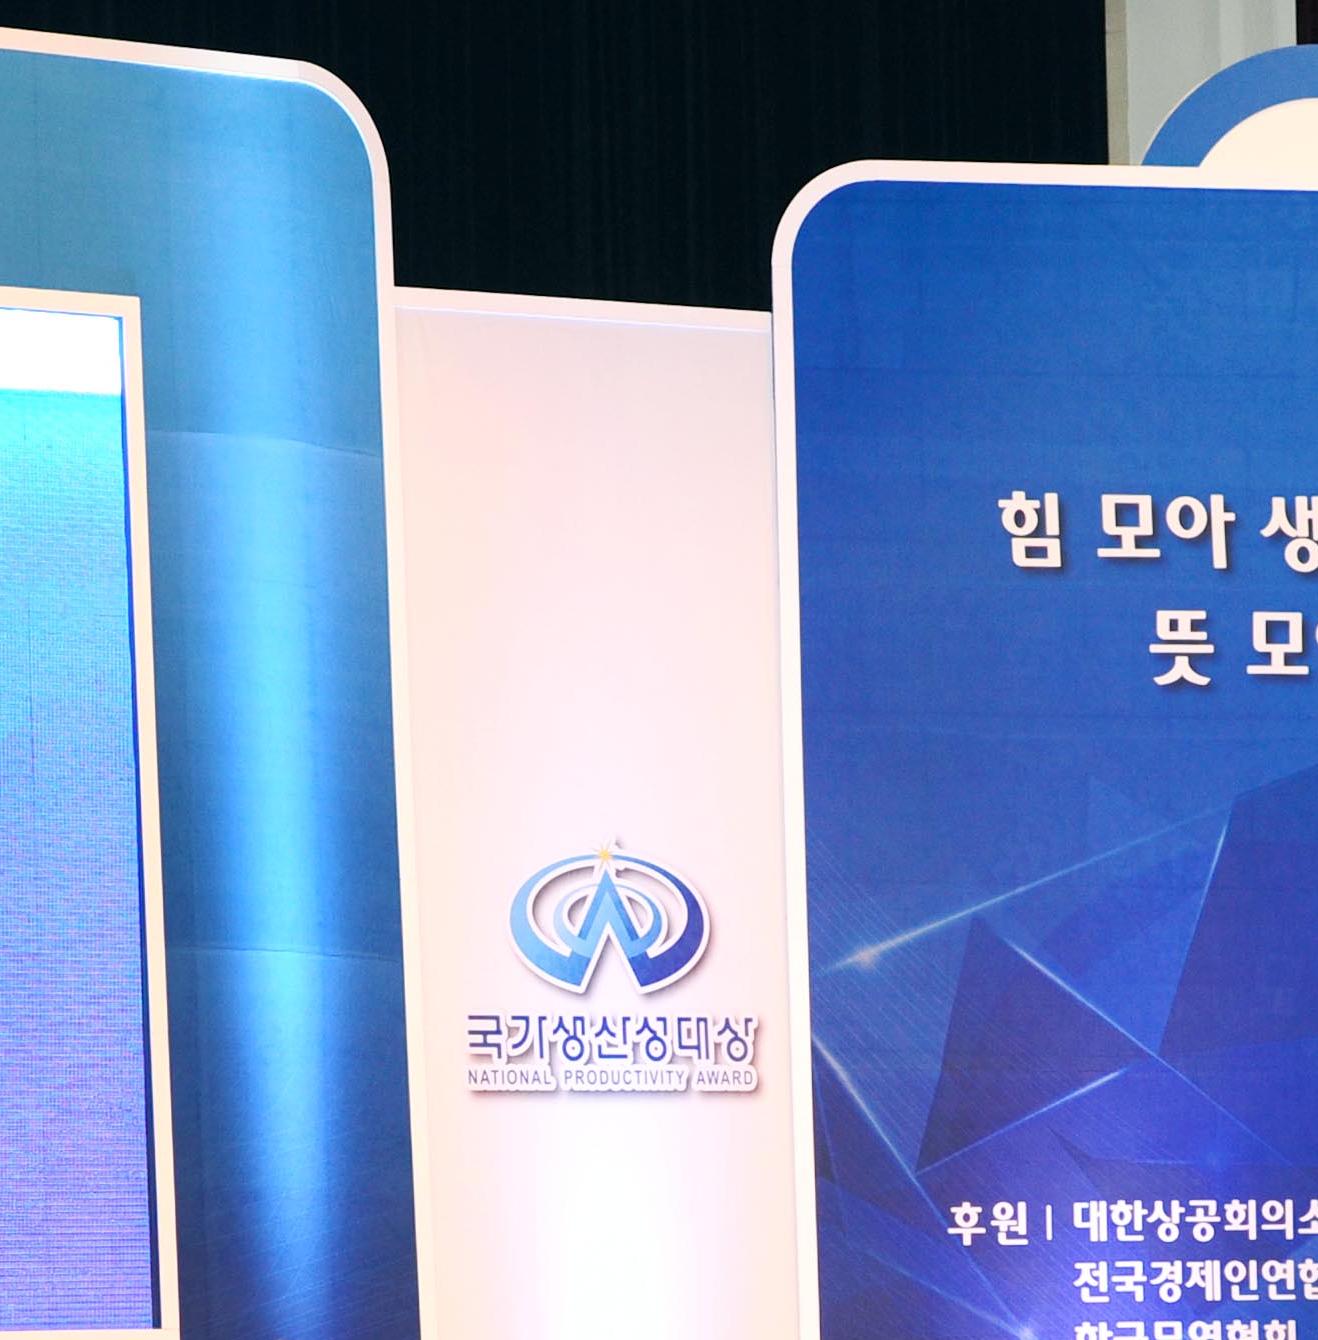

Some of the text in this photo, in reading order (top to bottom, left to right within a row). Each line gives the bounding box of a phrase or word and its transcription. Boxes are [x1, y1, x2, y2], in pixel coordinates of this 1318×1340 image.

[998, 491, 1062, 568] 힘
[1097, 494, 1235, 569] 모아
[1149, 610, 1215, 686] 뜻
[467, 1015, 754, 1063] 국가생산성대상
[467, 1069, 754, 1086] NATIONAL PRODUCTIVITY AWARD
[947, 1202, 1028, 1246] 후원
